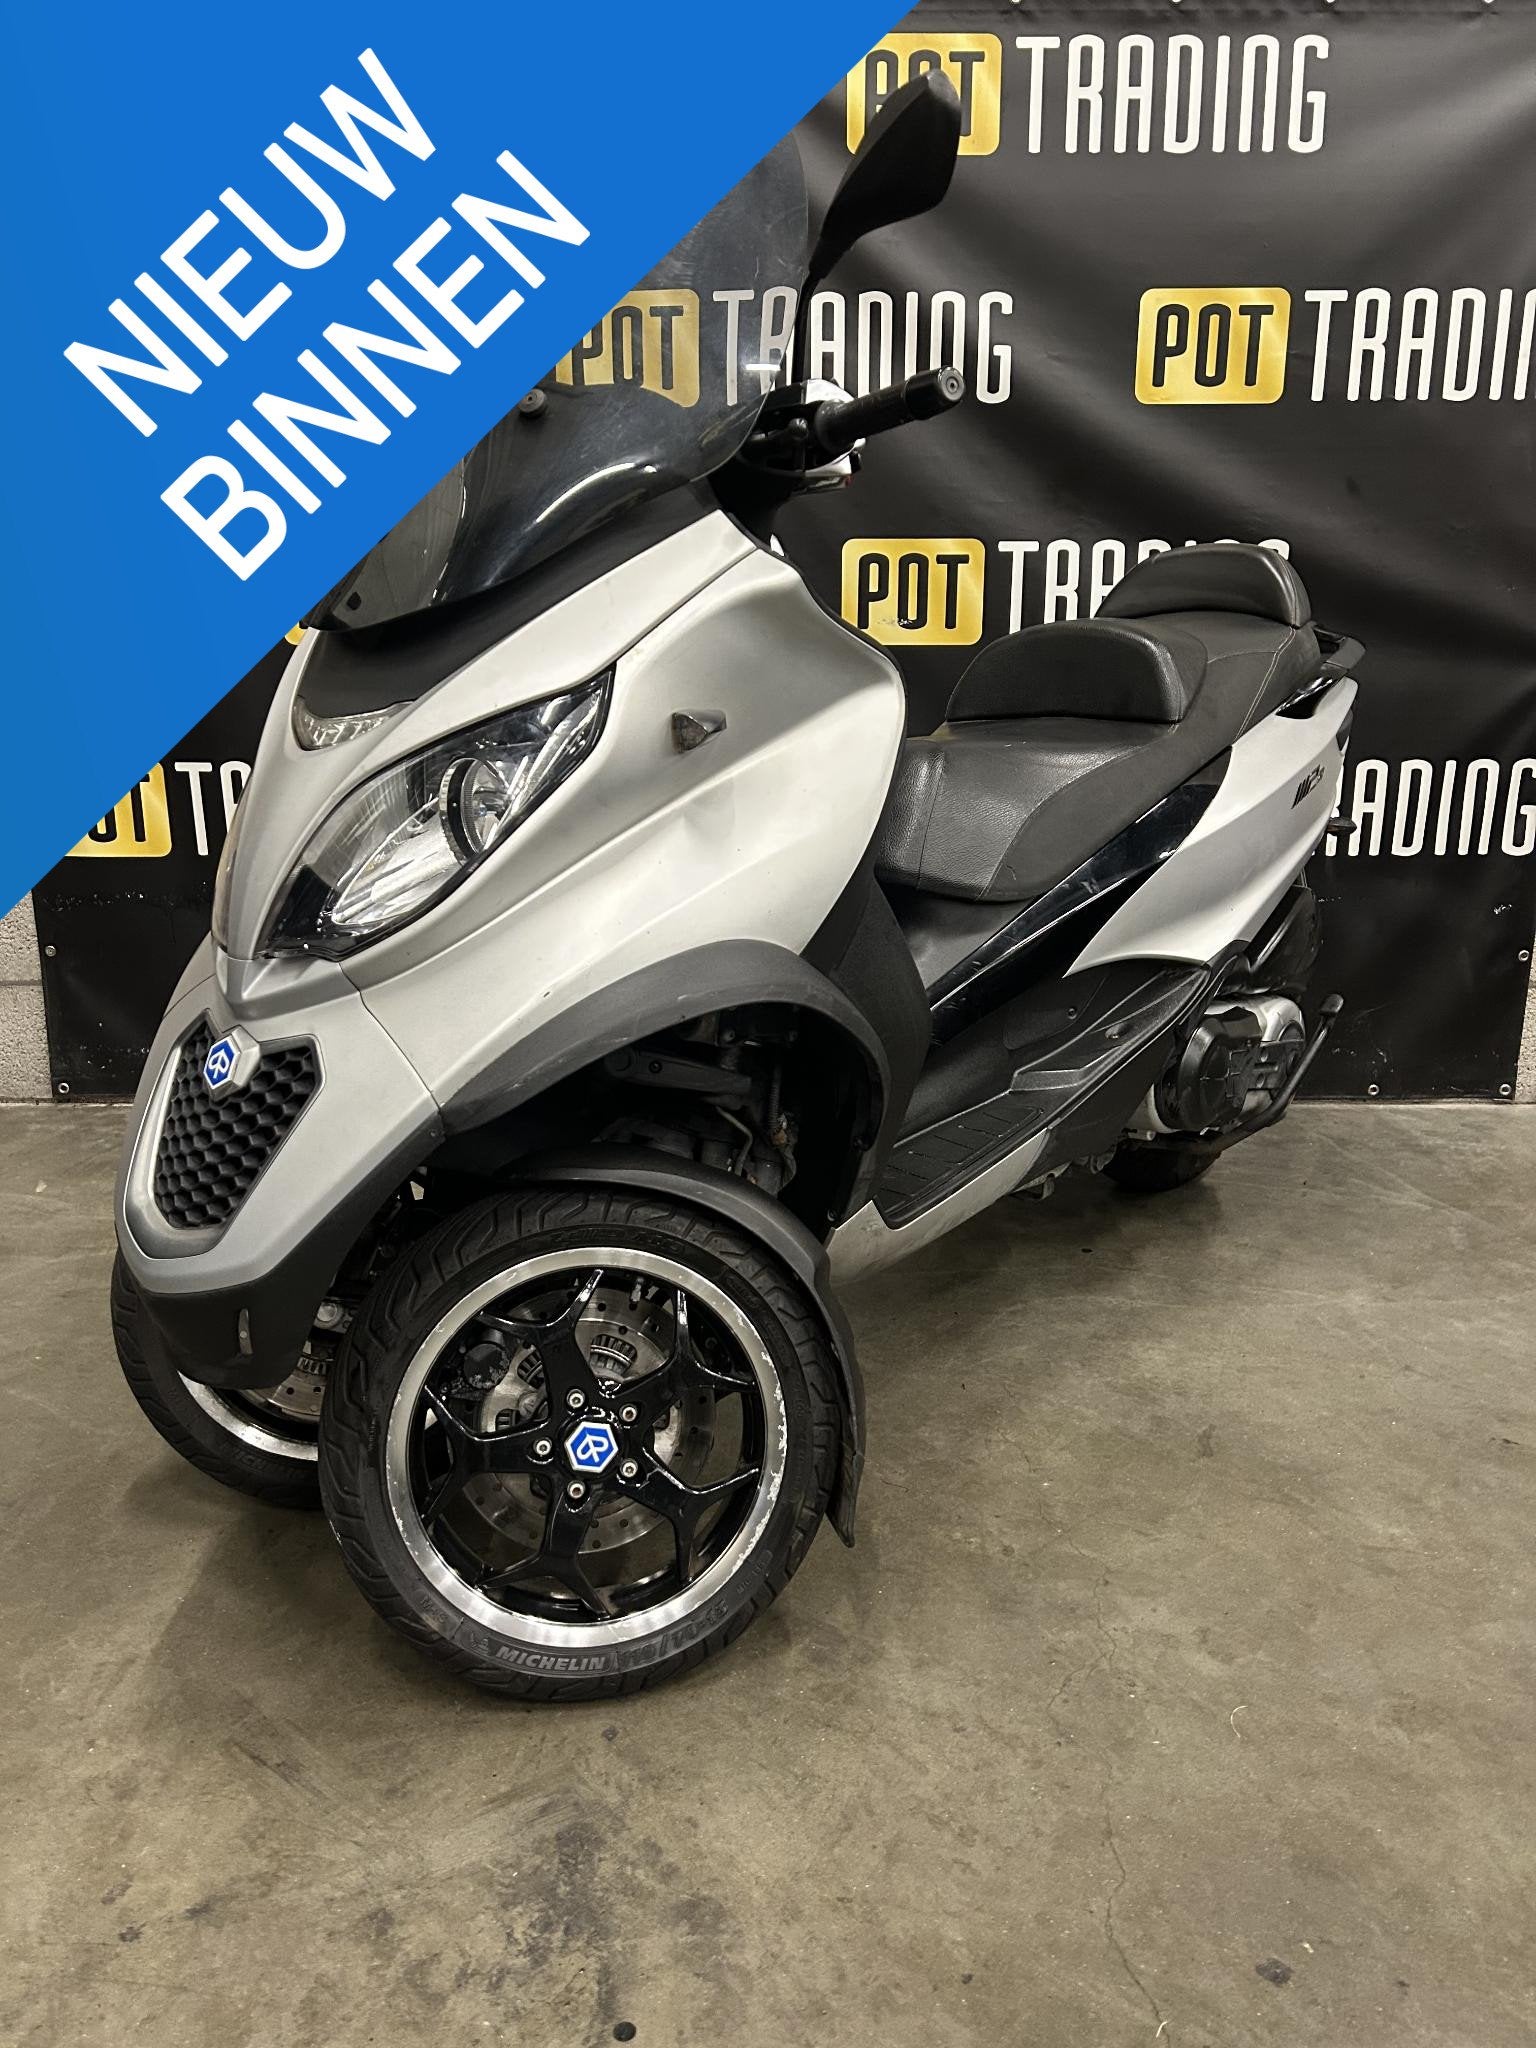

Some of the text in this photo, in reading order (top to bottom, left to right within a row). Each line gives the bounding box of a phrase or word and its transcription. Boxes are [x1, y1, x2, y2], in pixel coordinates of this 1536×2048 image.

[1015, 34, 1329, 154] TRADING
[712, 285, 1013, 404] TRADING
[1152, 303, 1274, 387] POT
[858, 552, 969, 630] POT
[1312, 758, 1536, 857] ADING
[496, 1645, 606, 1671] MICHELIN
